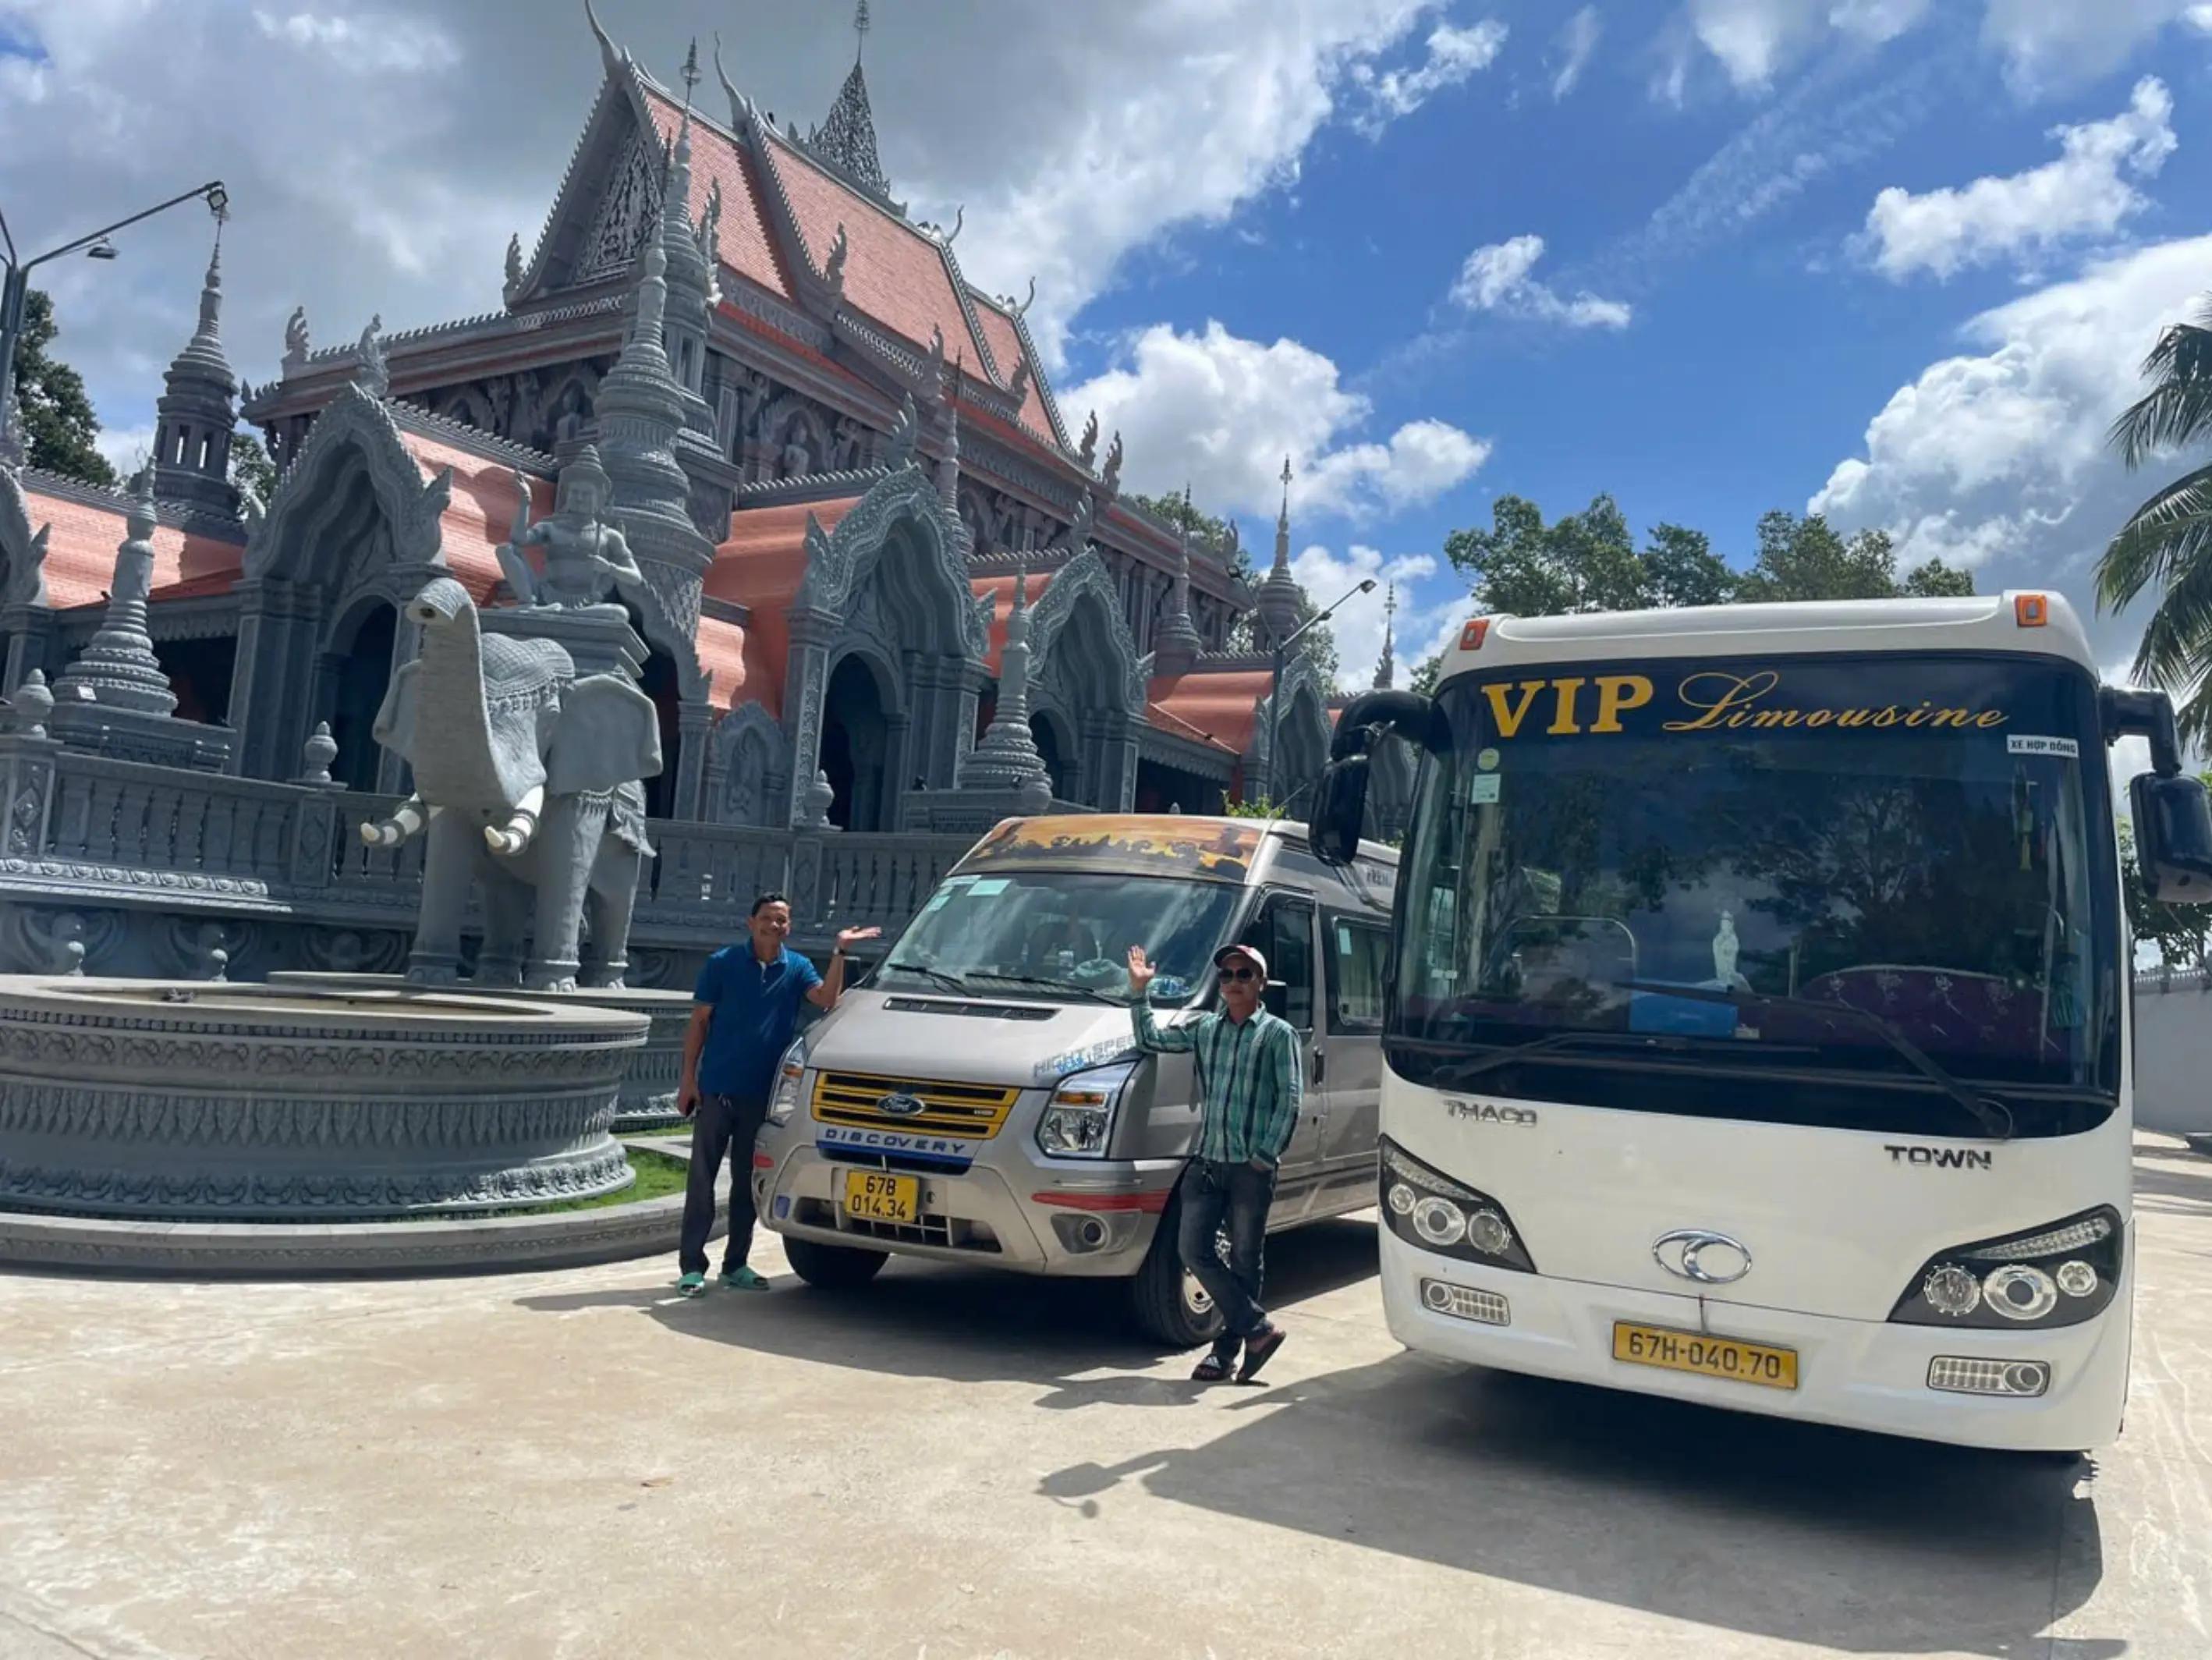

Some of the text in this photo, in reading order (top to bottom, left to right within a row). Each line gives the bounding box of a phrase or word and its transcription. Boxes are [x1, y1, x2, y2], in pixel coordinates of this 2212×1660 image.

[1480, 670, 2011, 738] VIP Limousine
[1443, 1099, 1537, 1125] THACO
[824, 1129, 966, 1154] DISCOVERY
[1884, 1144, 1992, 1169] TOWN
[866, 1175, 896, 1196] 67B
[852, 1194, 906, 1218] 014.34
[1629, 1332, 1781, 1379] 67H-040.70
